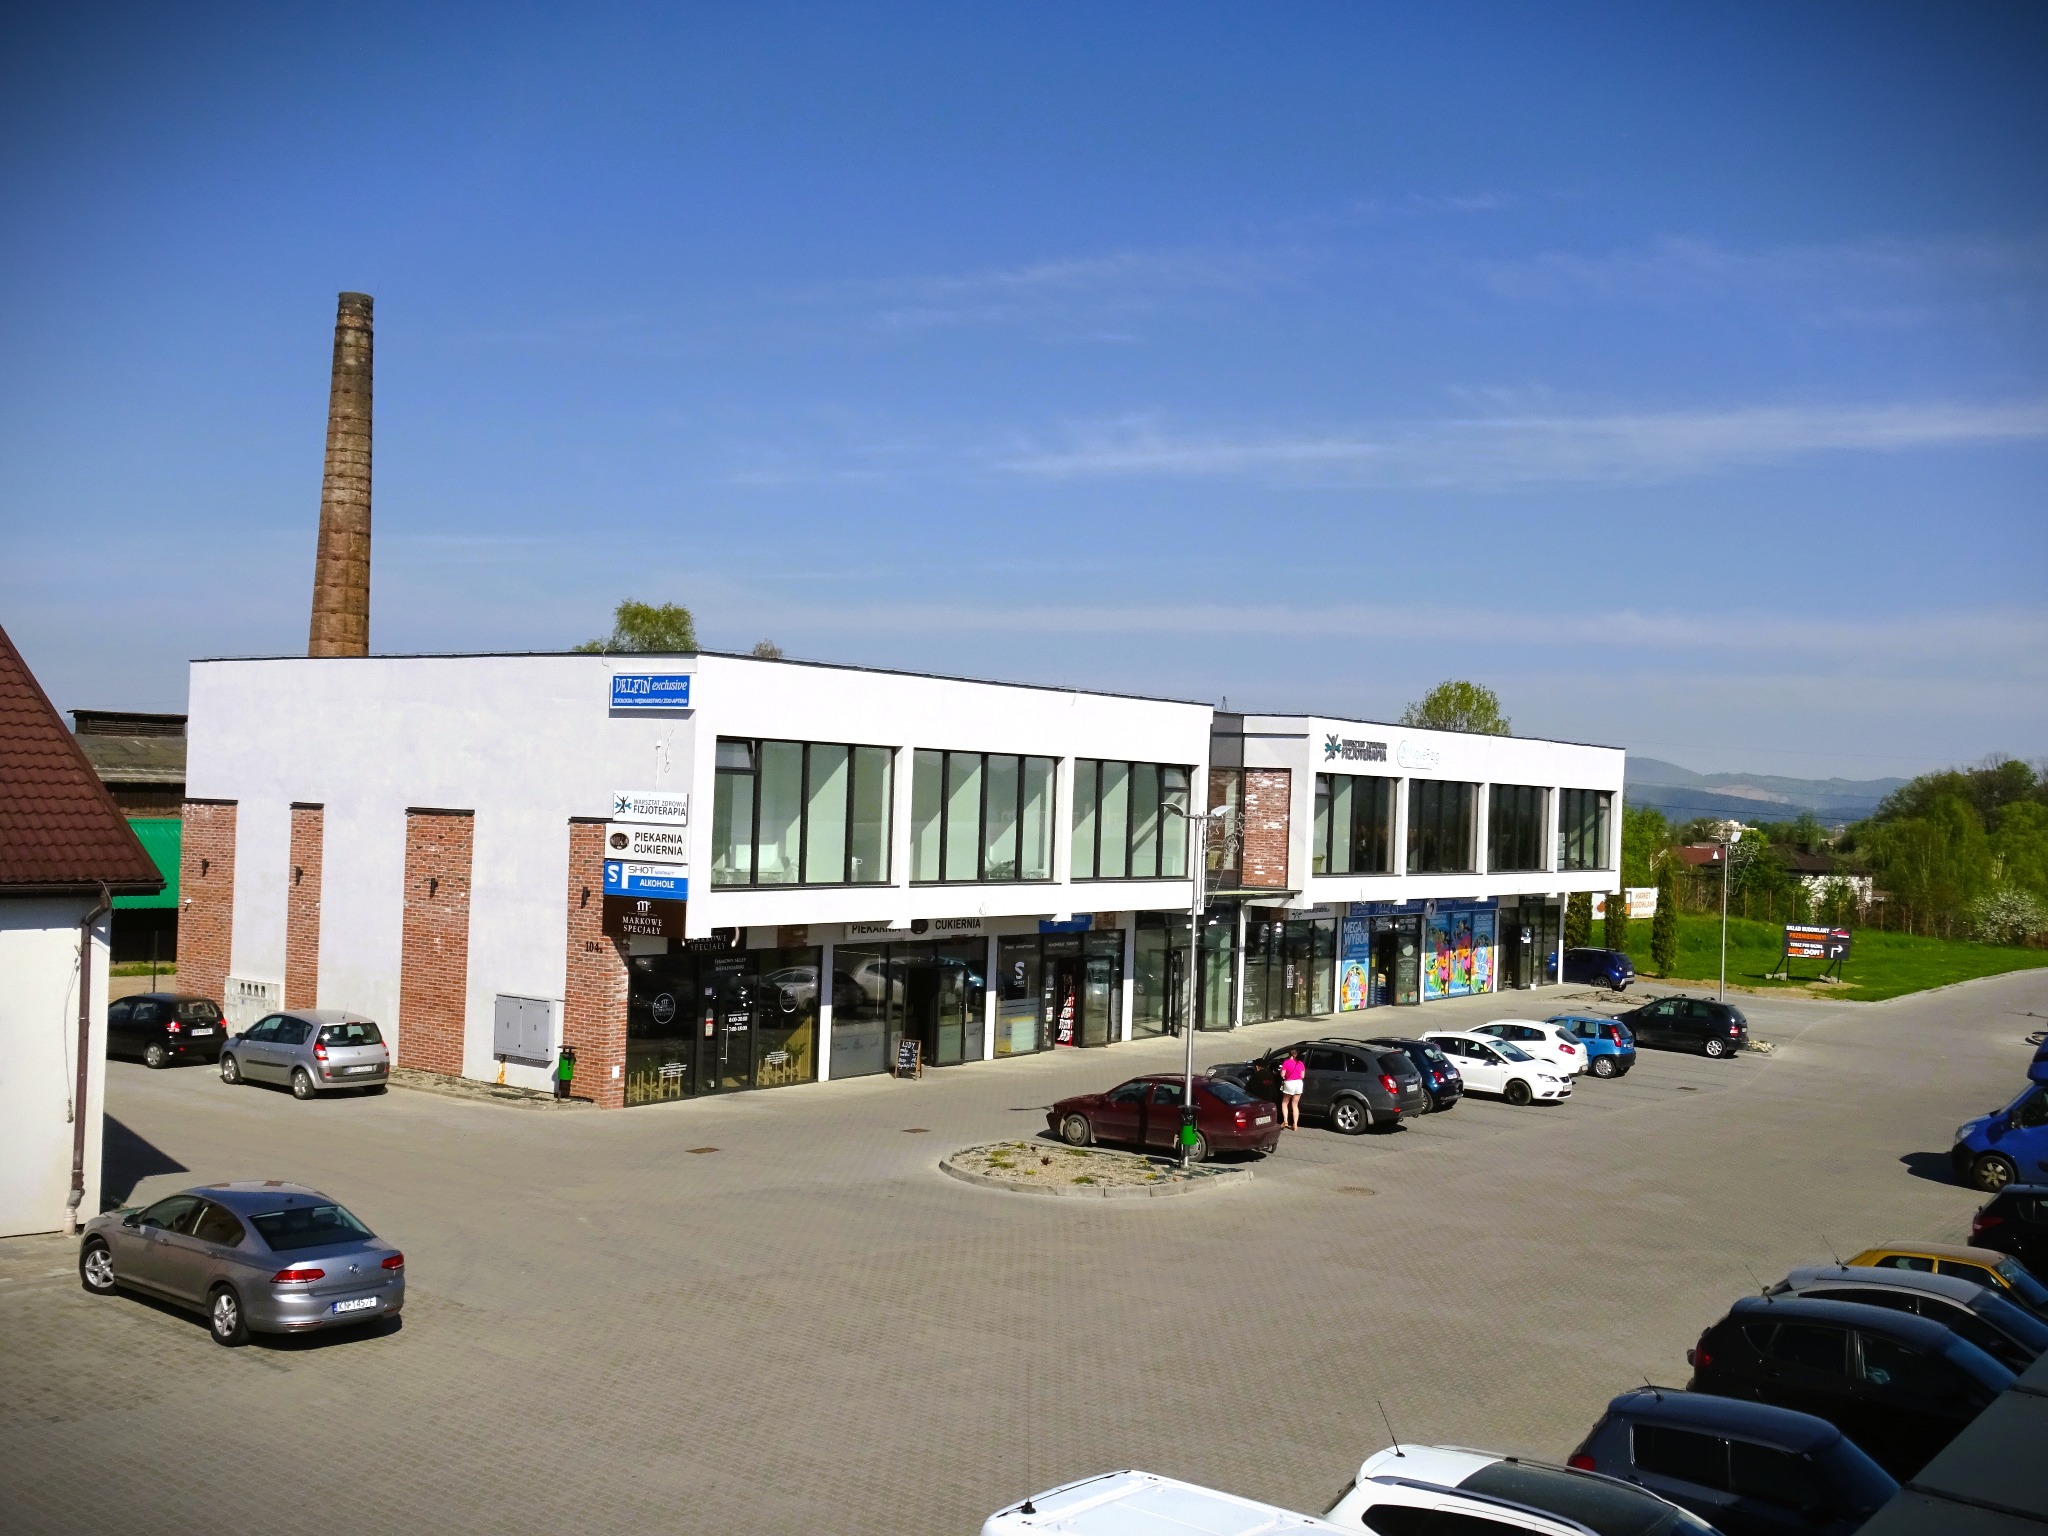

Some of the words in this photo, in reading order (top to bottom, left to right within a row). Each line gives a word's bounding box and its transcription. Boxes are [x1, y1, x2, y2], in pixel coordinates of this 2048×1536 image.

[615, 677, 653, 694] DELFIN
[652, 679, 688, 691] exclusive
[633, 798, 660, 806] WARSZTAT
[661, 800, 687, 808] ZDROWIA
[633, 804, 687, 817] FIZJOTERAPIA
[634, 831, 684, 844] PIEKARNIA
[633, 843, 684, 856] CUKIERNIA
[628, 865, 656, 875] SHOT
[639, 878, 675, 889] ALKOHOLE
[622, 915, 663, 927] MARKOWE
[935, 918, 981, 931] CUKIERNIA
[1343, 920, 1363, 935] MEGA
[623, 924, 661, 935] SPECJAŁY
